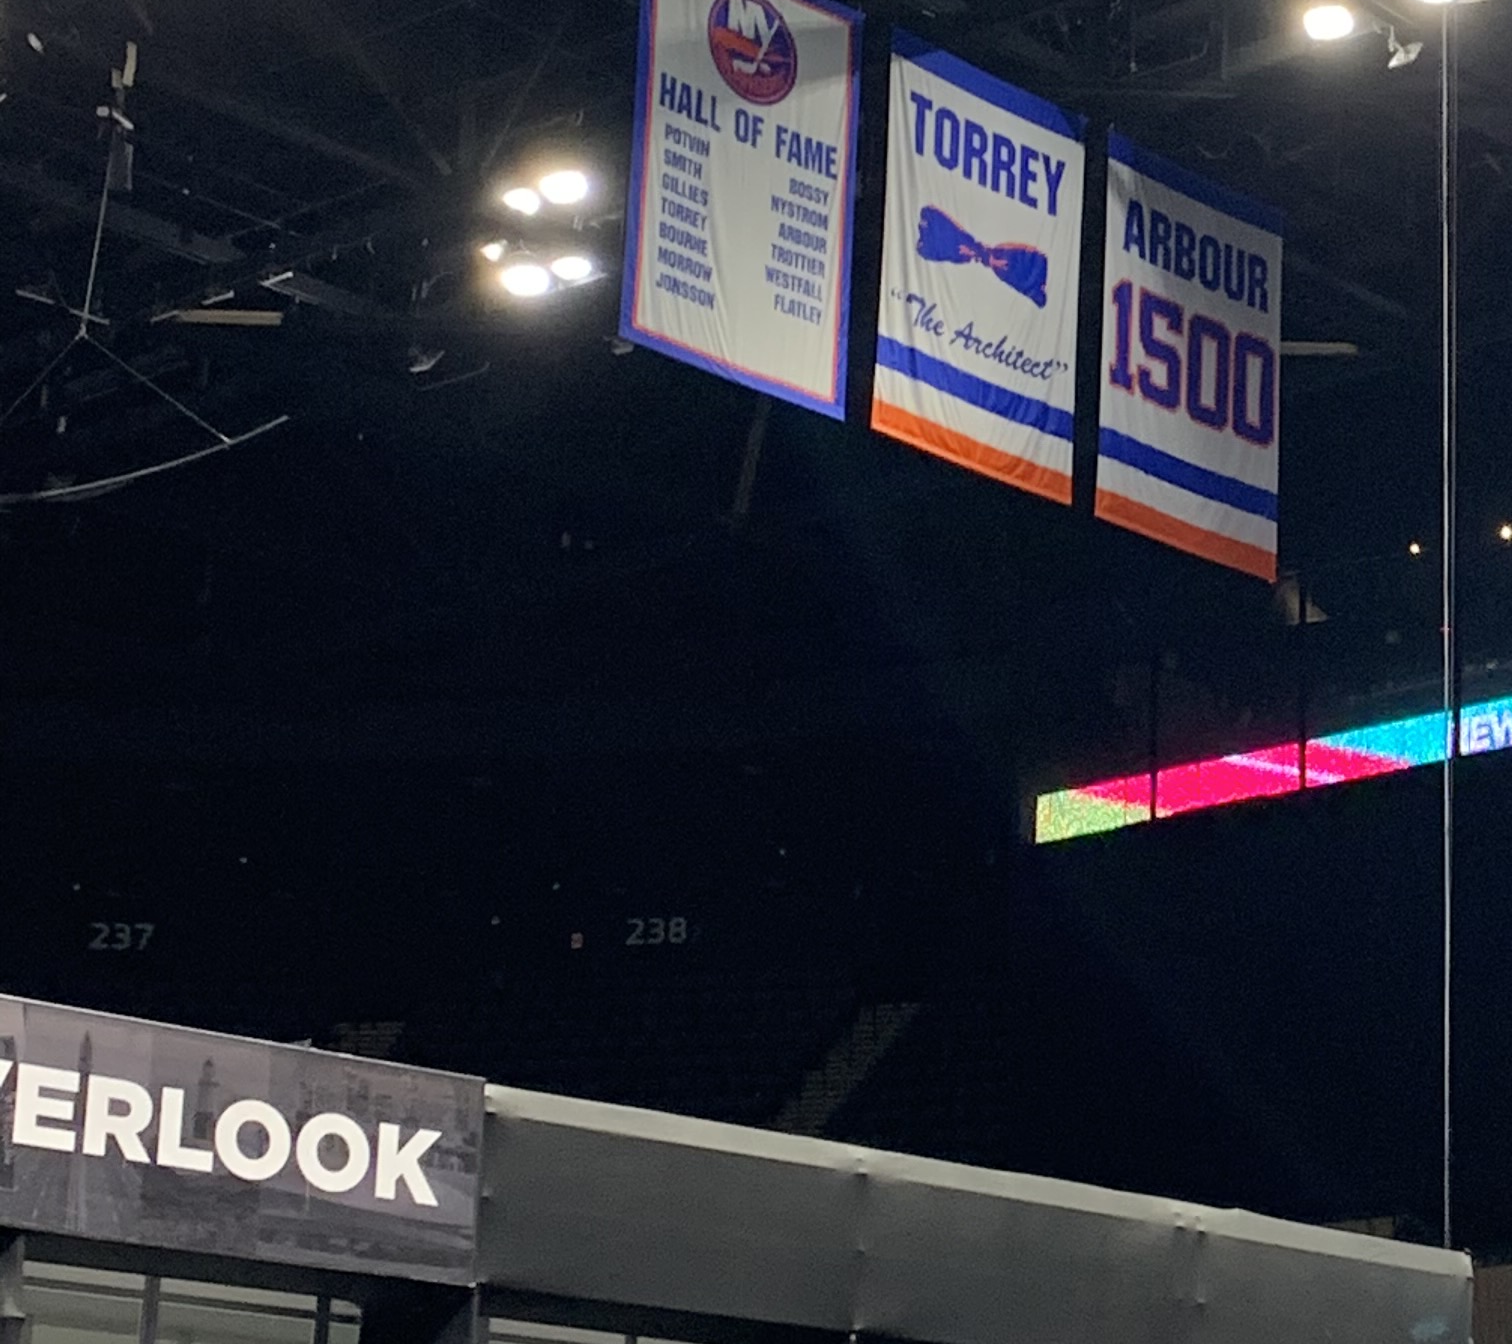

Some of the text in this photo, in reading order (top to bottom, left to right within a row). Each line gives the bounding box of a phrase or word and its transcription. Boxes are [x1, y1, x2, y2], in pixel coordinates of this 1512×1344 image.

[659, 72, 839, 181] HALL OF FAME
[664, 123, 711, 158] POTVIN
[663, 148, 703, 181] SMITH
[910, 89, 1066, 217] TORREY
[662, 173, 709, 207] GILLIES
[788, 177, 830, 208] BOSSY
[661, 197, 708, 232] TORREY
[771, 194, 829, 232] NYSTROM
[659, 221, 708, 258] BOURNE
[778, 221, 828, 256] ARBOUR
[1122, 199, 1269, 313] ARBOUR
[657, 245, 713, 284] MORROW
[771, 243, 826, 280] TROTTIER
[655, 271, 716, 311] JONSSON
[764, 264, 823, 303] WESTFALL
[773, 293, 823, 327] FLATLEY
[1109, 276, 1279, 449] 1500
[88, 921, 156, 952] 237
[625, 917, 689, 947] 238
[0, 1062, 444, 1208] ERLOOK
